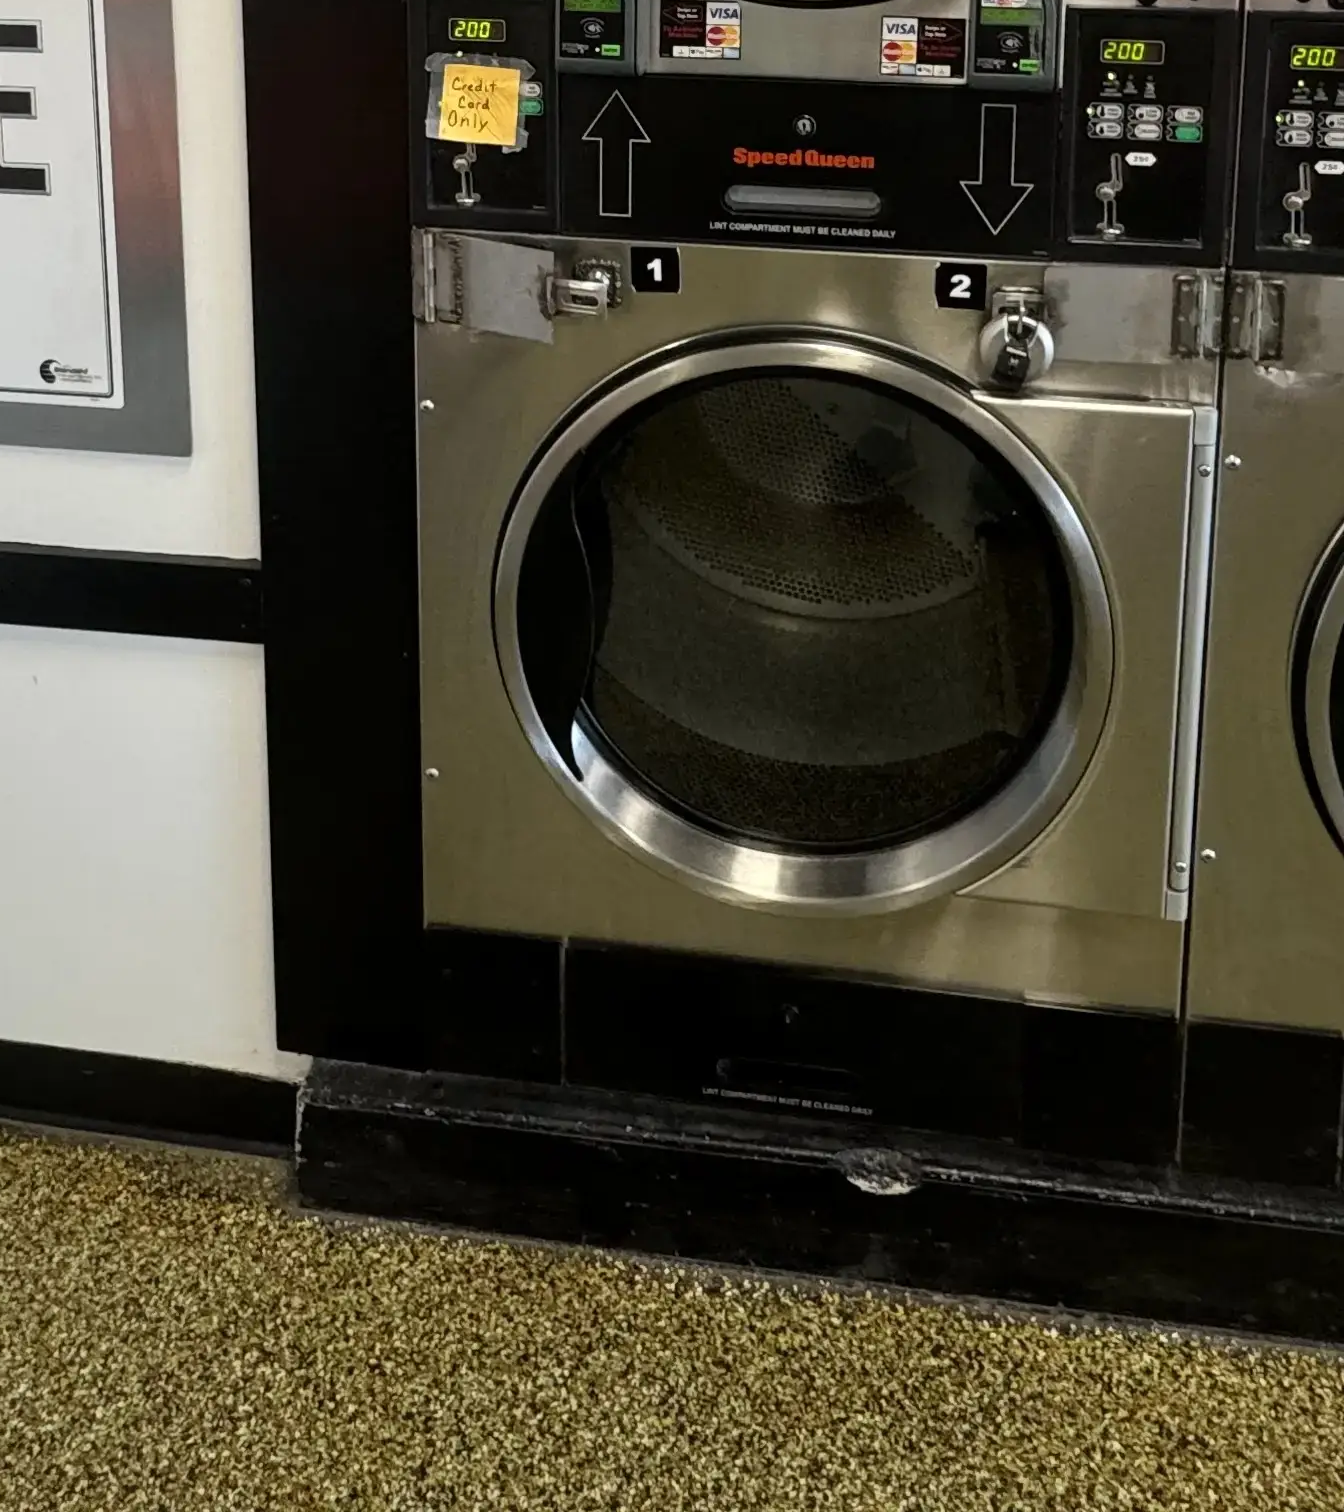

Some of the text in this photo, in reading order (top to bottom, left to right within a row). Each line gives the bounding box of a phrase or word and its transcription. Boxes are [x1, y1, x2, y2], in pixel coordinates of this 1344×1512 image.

[709, 8, 739, 19] VISA
[455, 21, 490, 38] 200
[885, 23, 916, 35] VISA
[1103, 42, 1145, 60] 200
[1292, 48, 1336, 66] 200
[452, 76, 497, 93] Credit
[458, 95, 490, 110] Card
[447, 109, 488, 132] Only
[733, 147, 875, 169] Speed Queen
[709, 221, 897, 239] LINT COMPARTMENT MUST BE CLEANED DAILY
[647, 258, 662, 282] 1
[949, 273, 972, 299] 2
